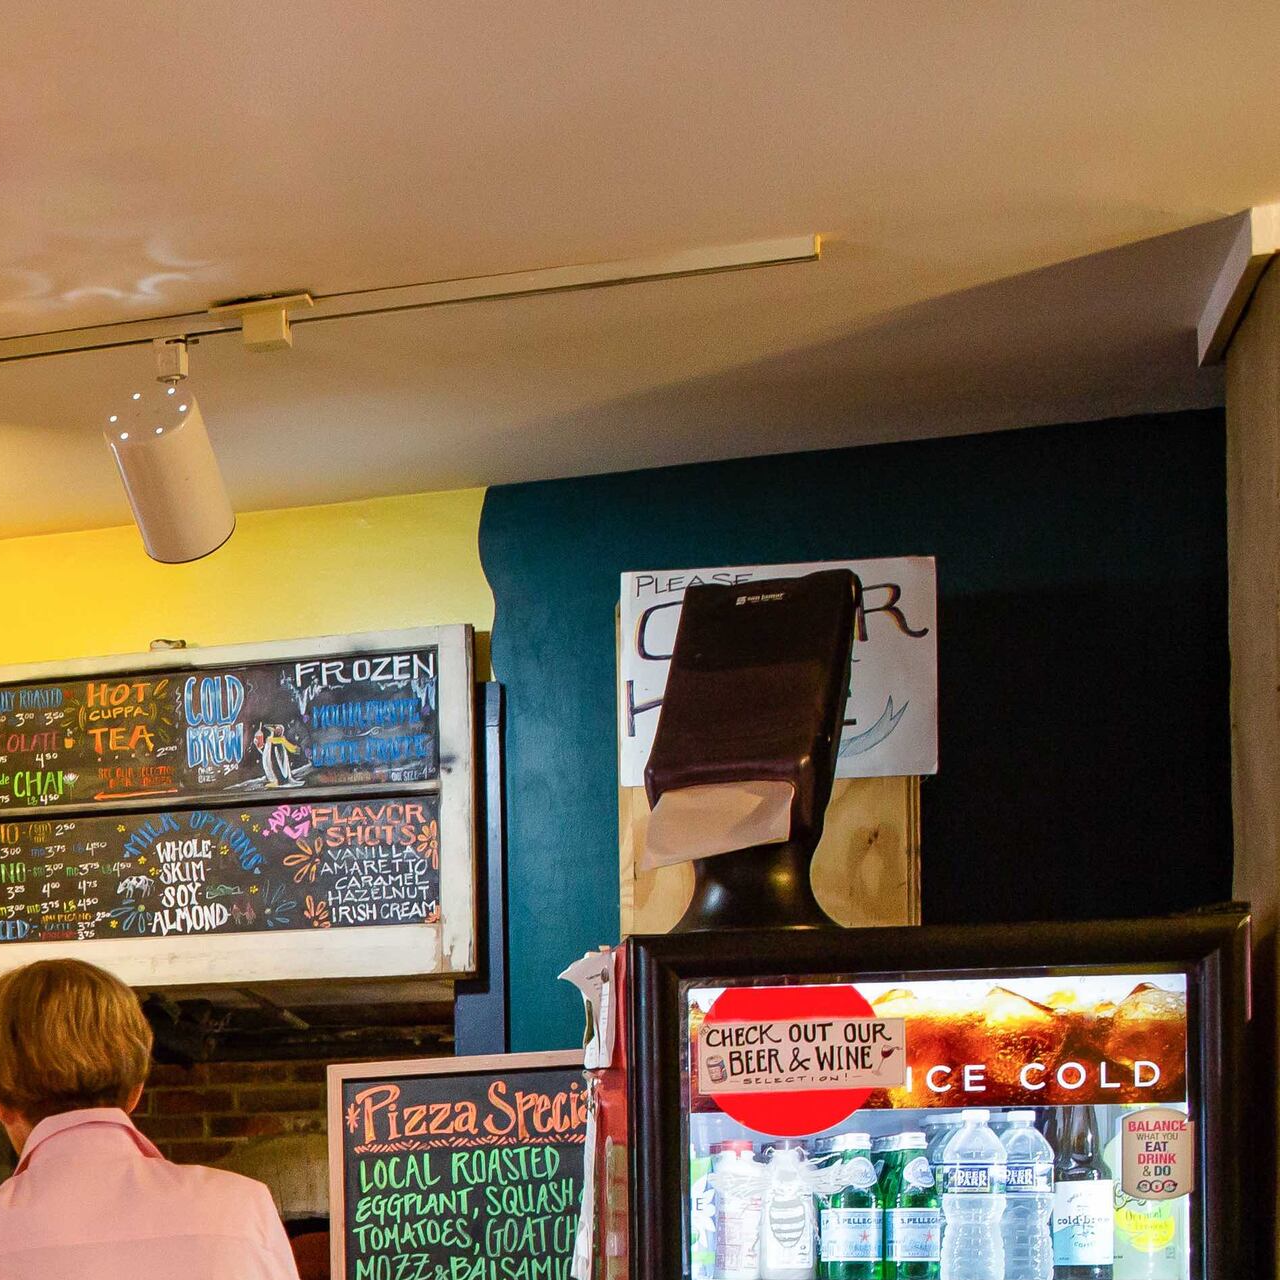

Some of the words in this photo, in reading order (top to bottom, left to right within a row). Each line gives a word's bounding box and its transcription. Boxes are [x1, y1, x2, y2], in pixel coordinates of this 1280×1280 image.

[295, 652, 435, 688] FROZEN
[86, 682, 152, 708] HOT
[184, 674, 245, 726] COLD
[89, 706, 150, 722] CUPPA
[87, 725, 156, 755] TEA
[186, 722, 245, 769] BREW
[13, 769, 65, 798] CHAI
[312, 803, 427, 829] FLAVOR
[123, 812, 181, 857] MILK
[189, 810, 264, 871] OPTIONS
[326, 824, 418, 848] SHOTS
[327, 844, 421, 861] VANILLA
[321, 858, 429, 877] AMARETTO
[335, 872, 430, 891] CARAMEL
[327, 885, 430, 907] HAZELNUT
[332, 903, 377, 924] IRISH
[380, 900, 437, 921] CREAM
[705, 1024, 783, 1048] CHECK
[789, 1022, 834, 1044] OUT
[844, 1022, 893, 1044] OUR
[728, 1048, 785, 1077] BEER
[789, 1047, 811, 1072] &
[814, 1045, 874, 1072] WINE
[906, 1064, 987, 1094] ICE
[1019, 1060, 1162, 1091] COLD
[355, 1084, 479, 1144] Pizza
[1127, 1120, 1188, 1133] BALANCE
[1136, 1132, 1161, 1142] WHAT
[1162, 1132, 1180, 1142] YOU
[1144, 1141, 1169, 1153] EAT
[359, 1152, 441, 1194] LOCAL
[450, 1145, 561, 1188] ROASTED
[1137, 1153, 1177, 1165] DRINK
[1142, 1165, 1152, 1177] &
[1153, 1165, 1172, 1177] DO
[955, 1177, 990, 1188] PARK
[957, 1168, 988, 1180] DEER
[354, 1186, 480, 1226] EGGPLANT,
[484, 1178, 574, 1218] SQUASH
[352, 1220, 480, 1256] TOMATOES,
[485, 1217, 556, 1258] GOAT
